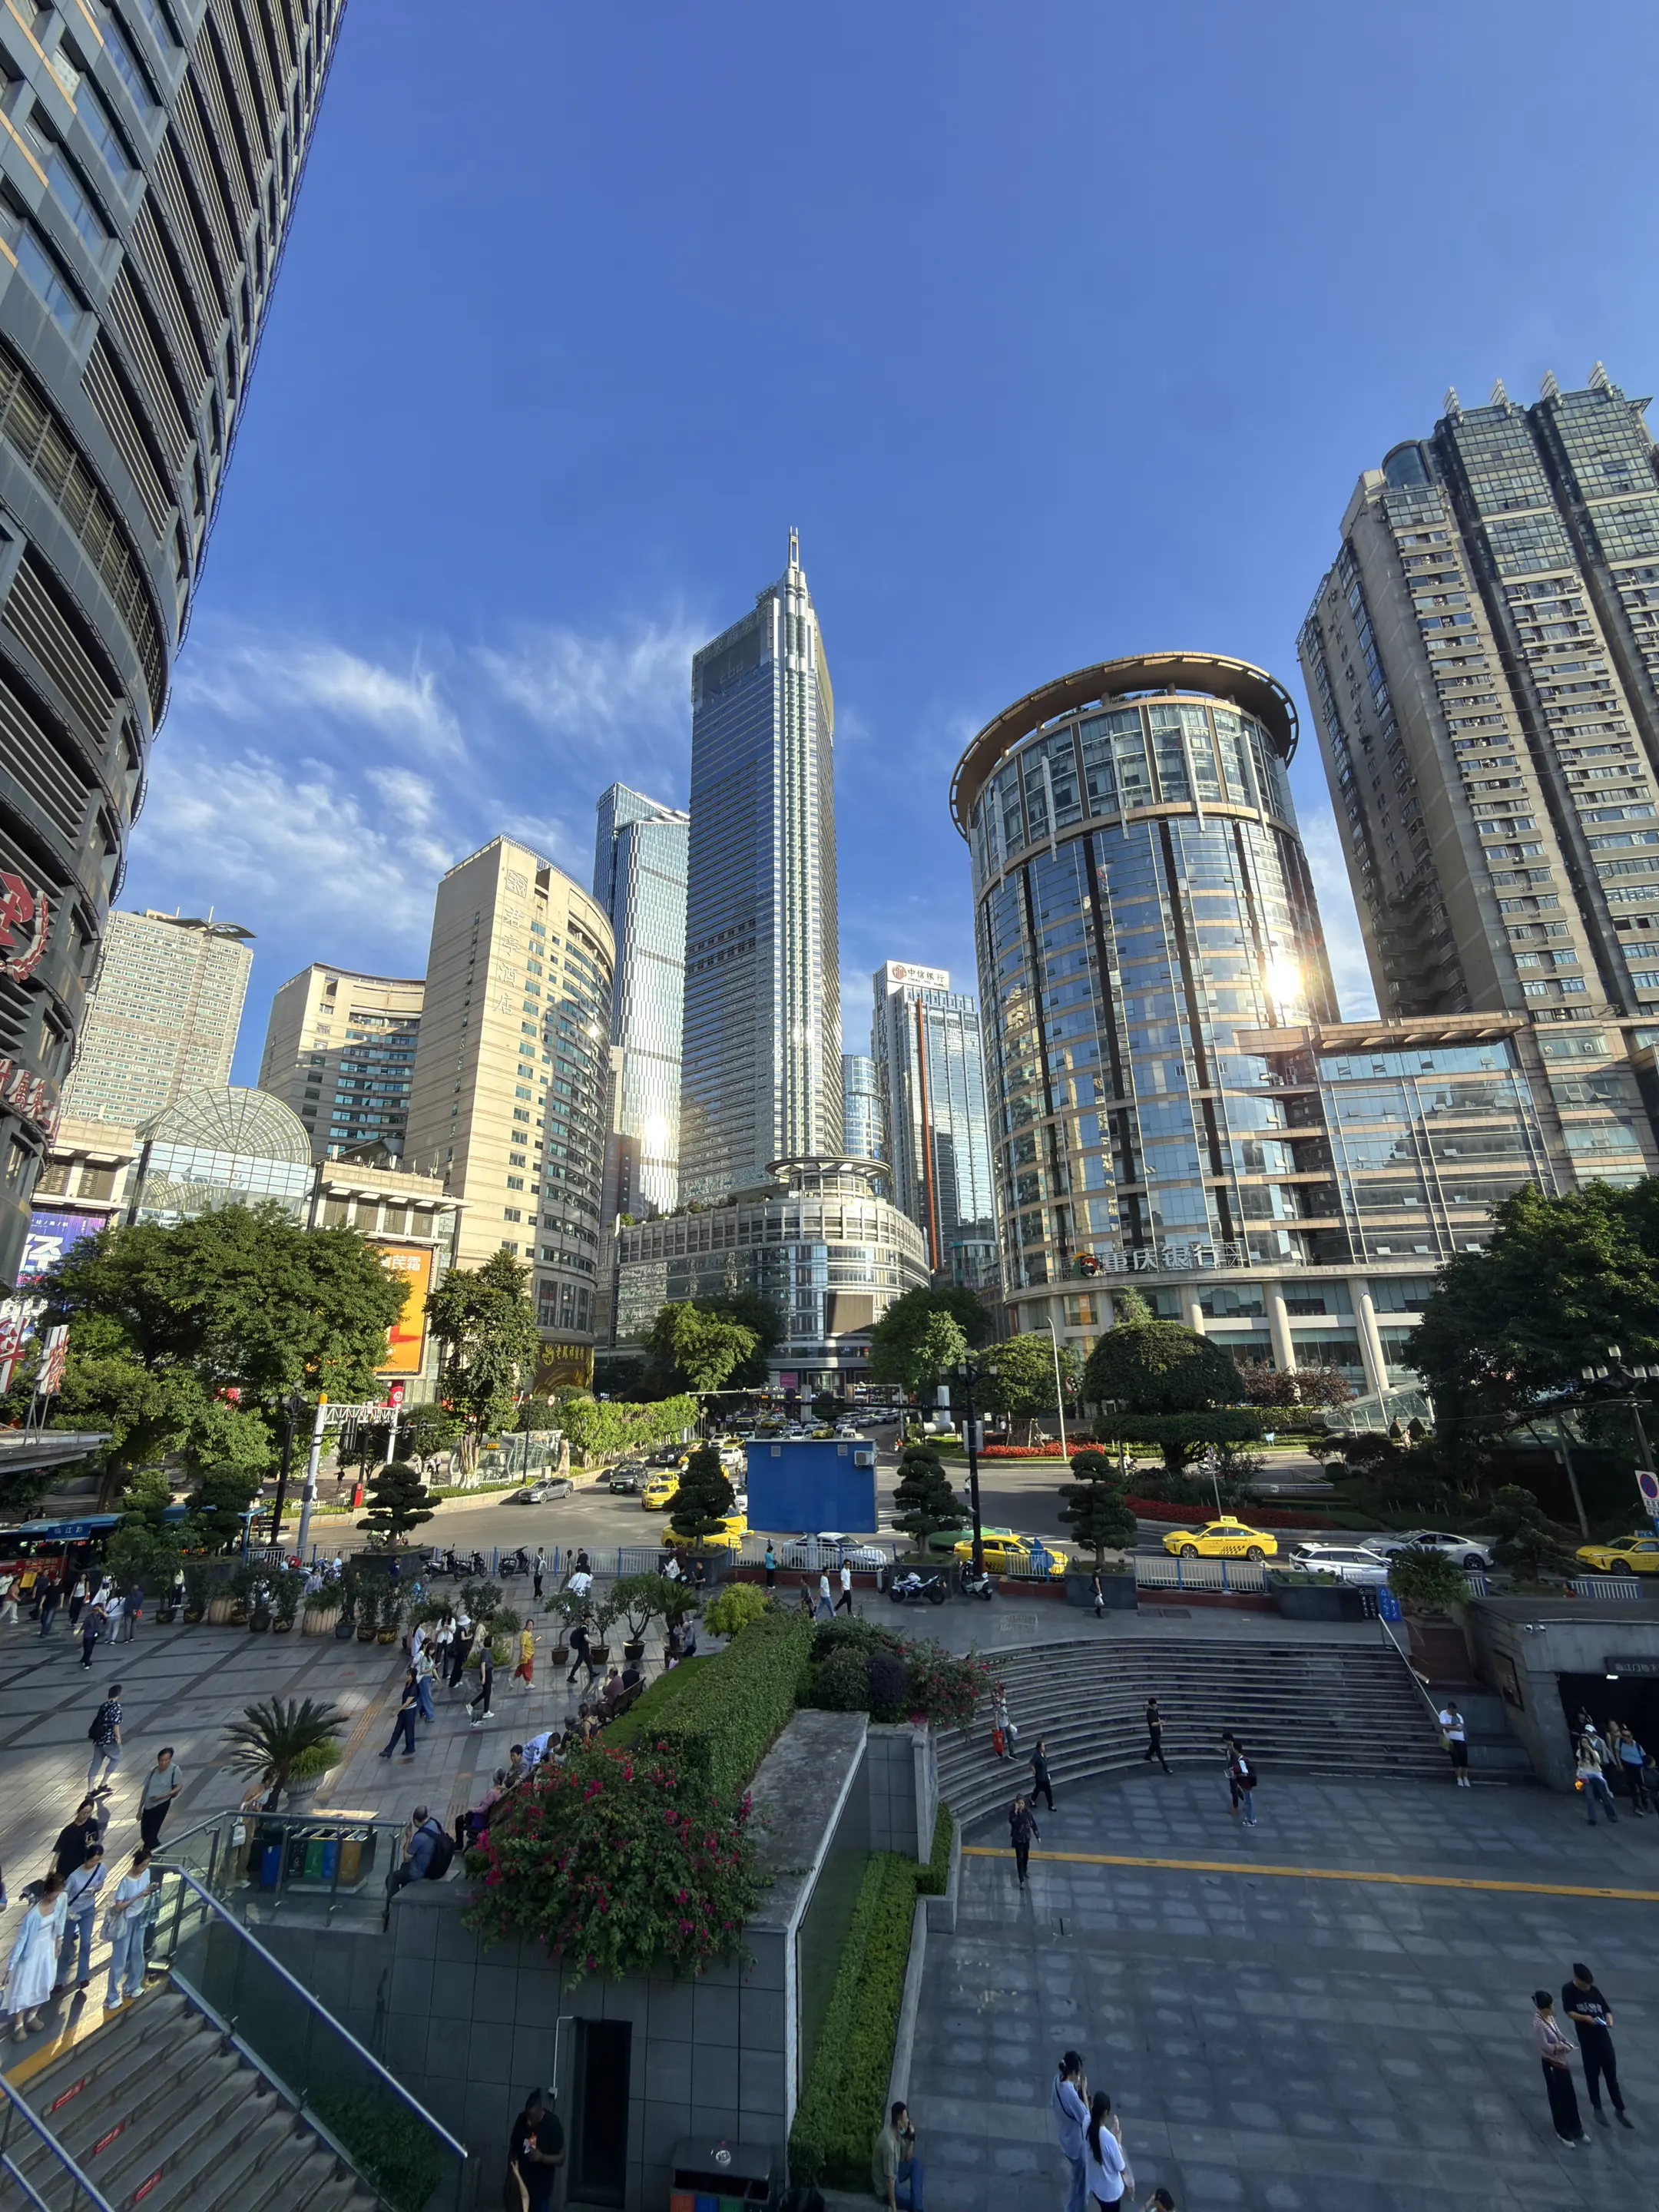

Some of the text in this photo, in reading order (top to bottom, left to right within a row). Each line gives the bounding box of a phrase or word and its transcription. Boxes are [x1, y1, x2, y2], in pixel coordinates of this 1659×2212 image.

[493, 906, 524, 1016] 君亭酒店
[907, 967, 945, 983] 中信银行
[1104, 1243, 1220, 1274] 重庆银行
